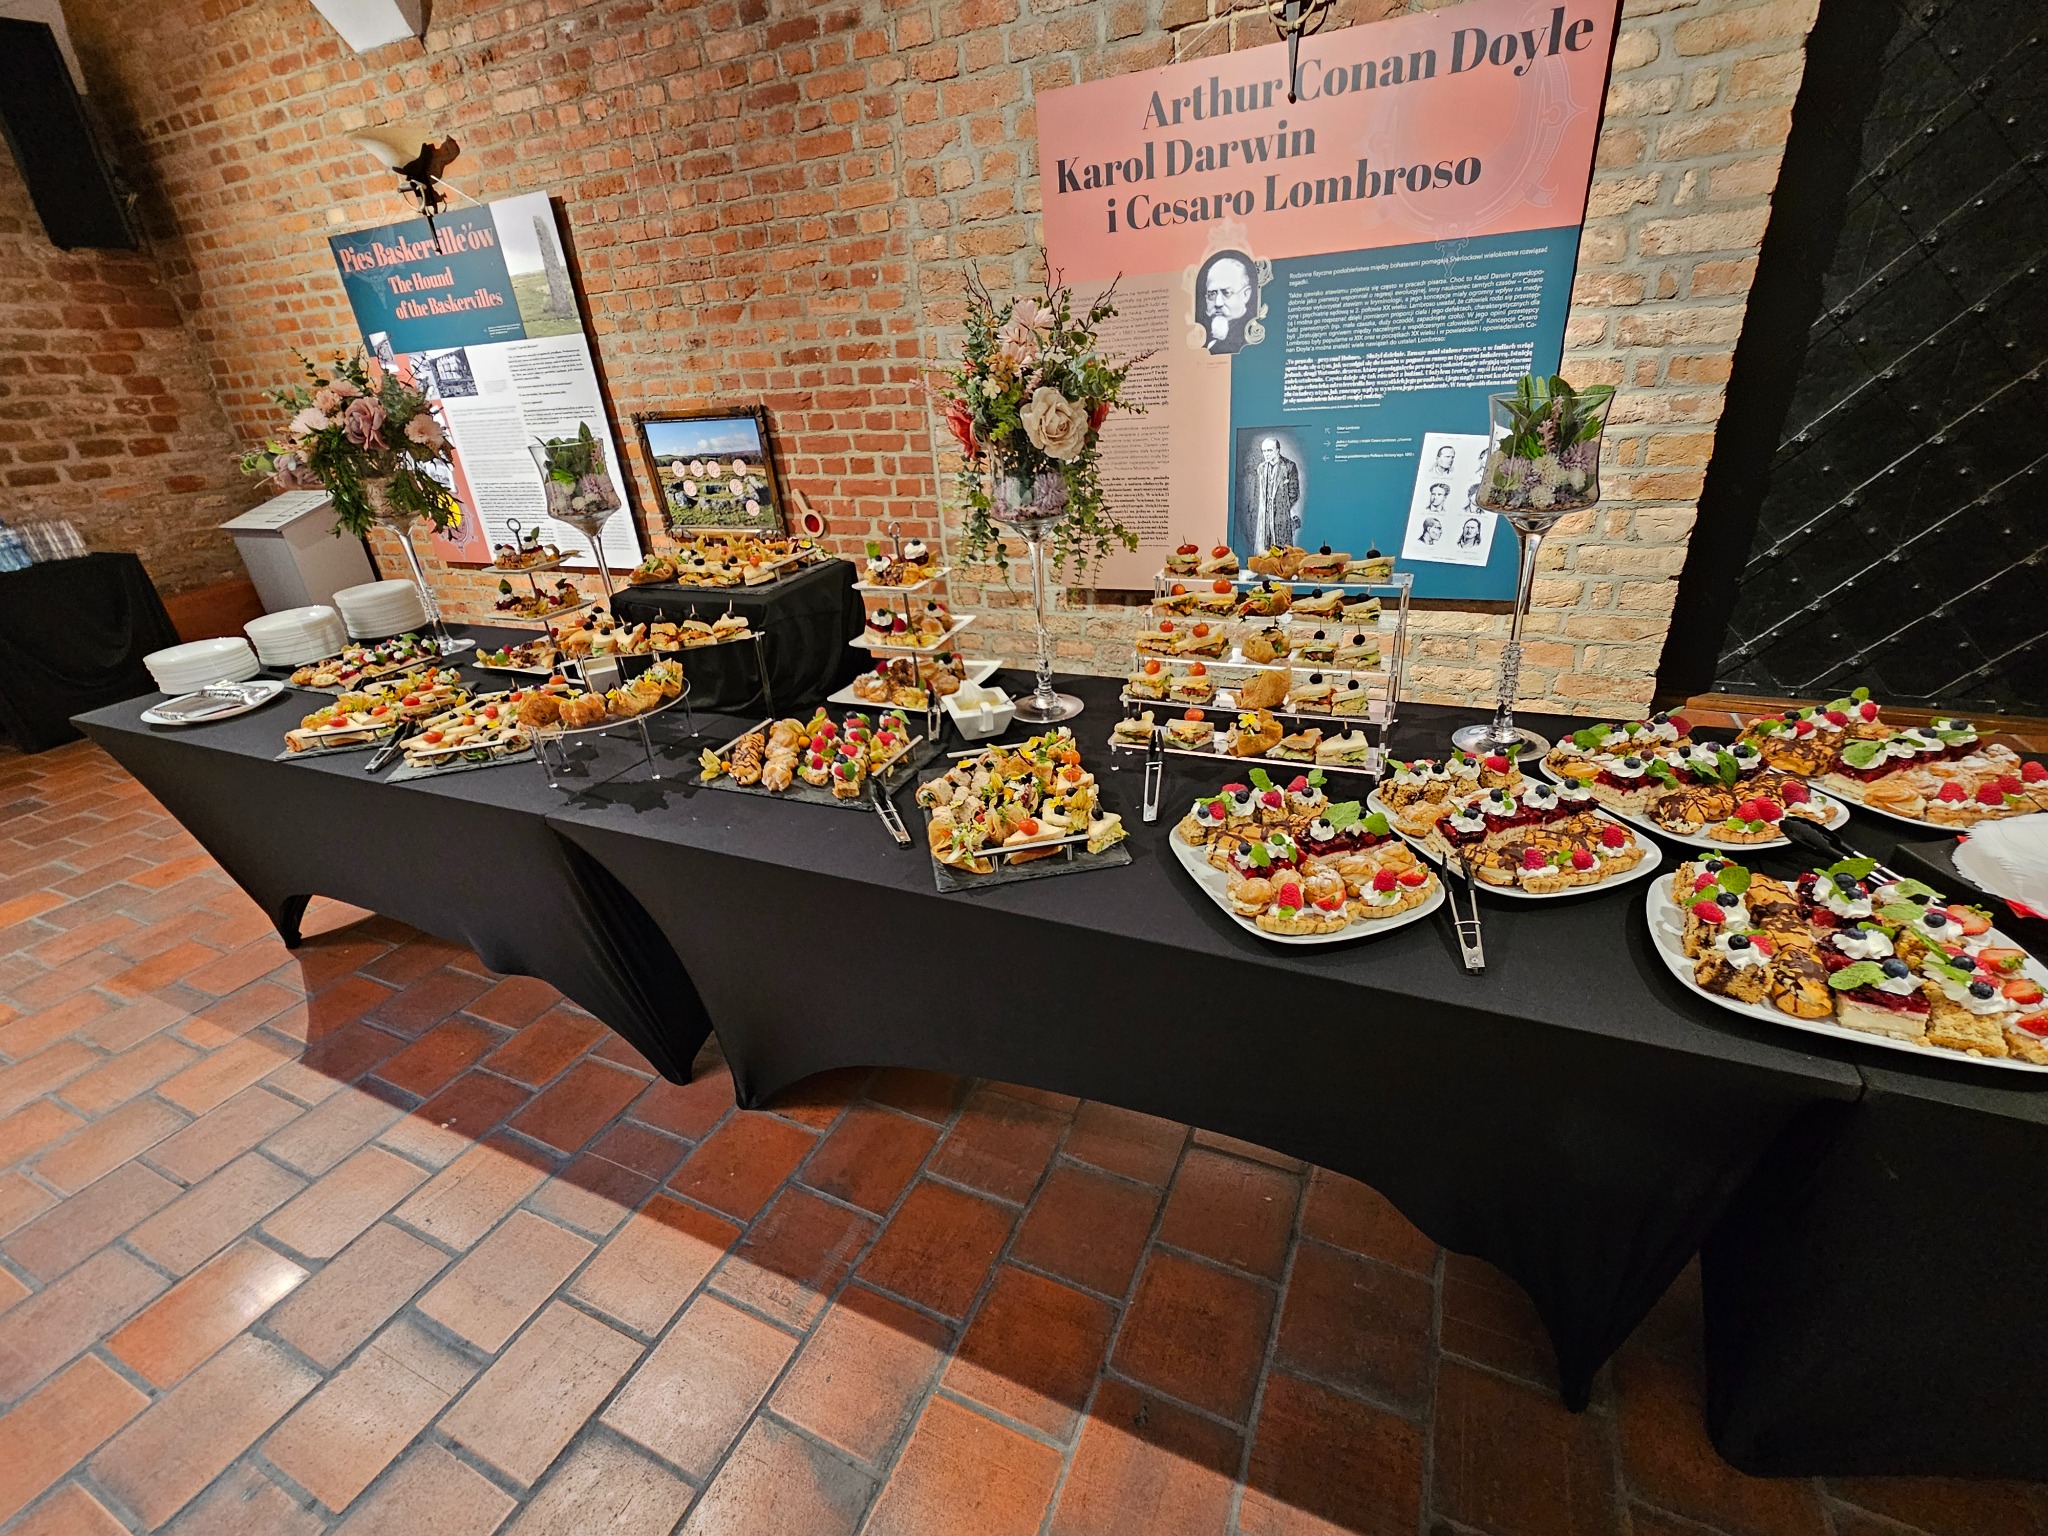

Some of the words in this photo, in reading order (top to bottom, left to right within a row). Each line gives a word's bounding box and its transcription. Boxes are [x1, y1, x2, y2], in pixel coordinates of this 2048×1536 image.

[1142, 76, 1282, 130] Arthur
[1296, 49, 1437, 102] Conan
[1447, 6, 1594, 76] Doyle
[1055, 141, 1156, 194] Karol
[1164, 119, 1316, 177] Darwin
[1107, 198, 1118, 233] i
[1126, 190, 1254, 231] Cesaro
[1263, 156, 1481, 212] Lombroso
[338, 246, 375, 273] Pies
[387, 275, 413, 294] The
[411, 266, 454, 290] Hound
[395, 300, 410, 319] of
[407, 299, 430, 317] the
[427, 288, 503, 315] Baskervilles
